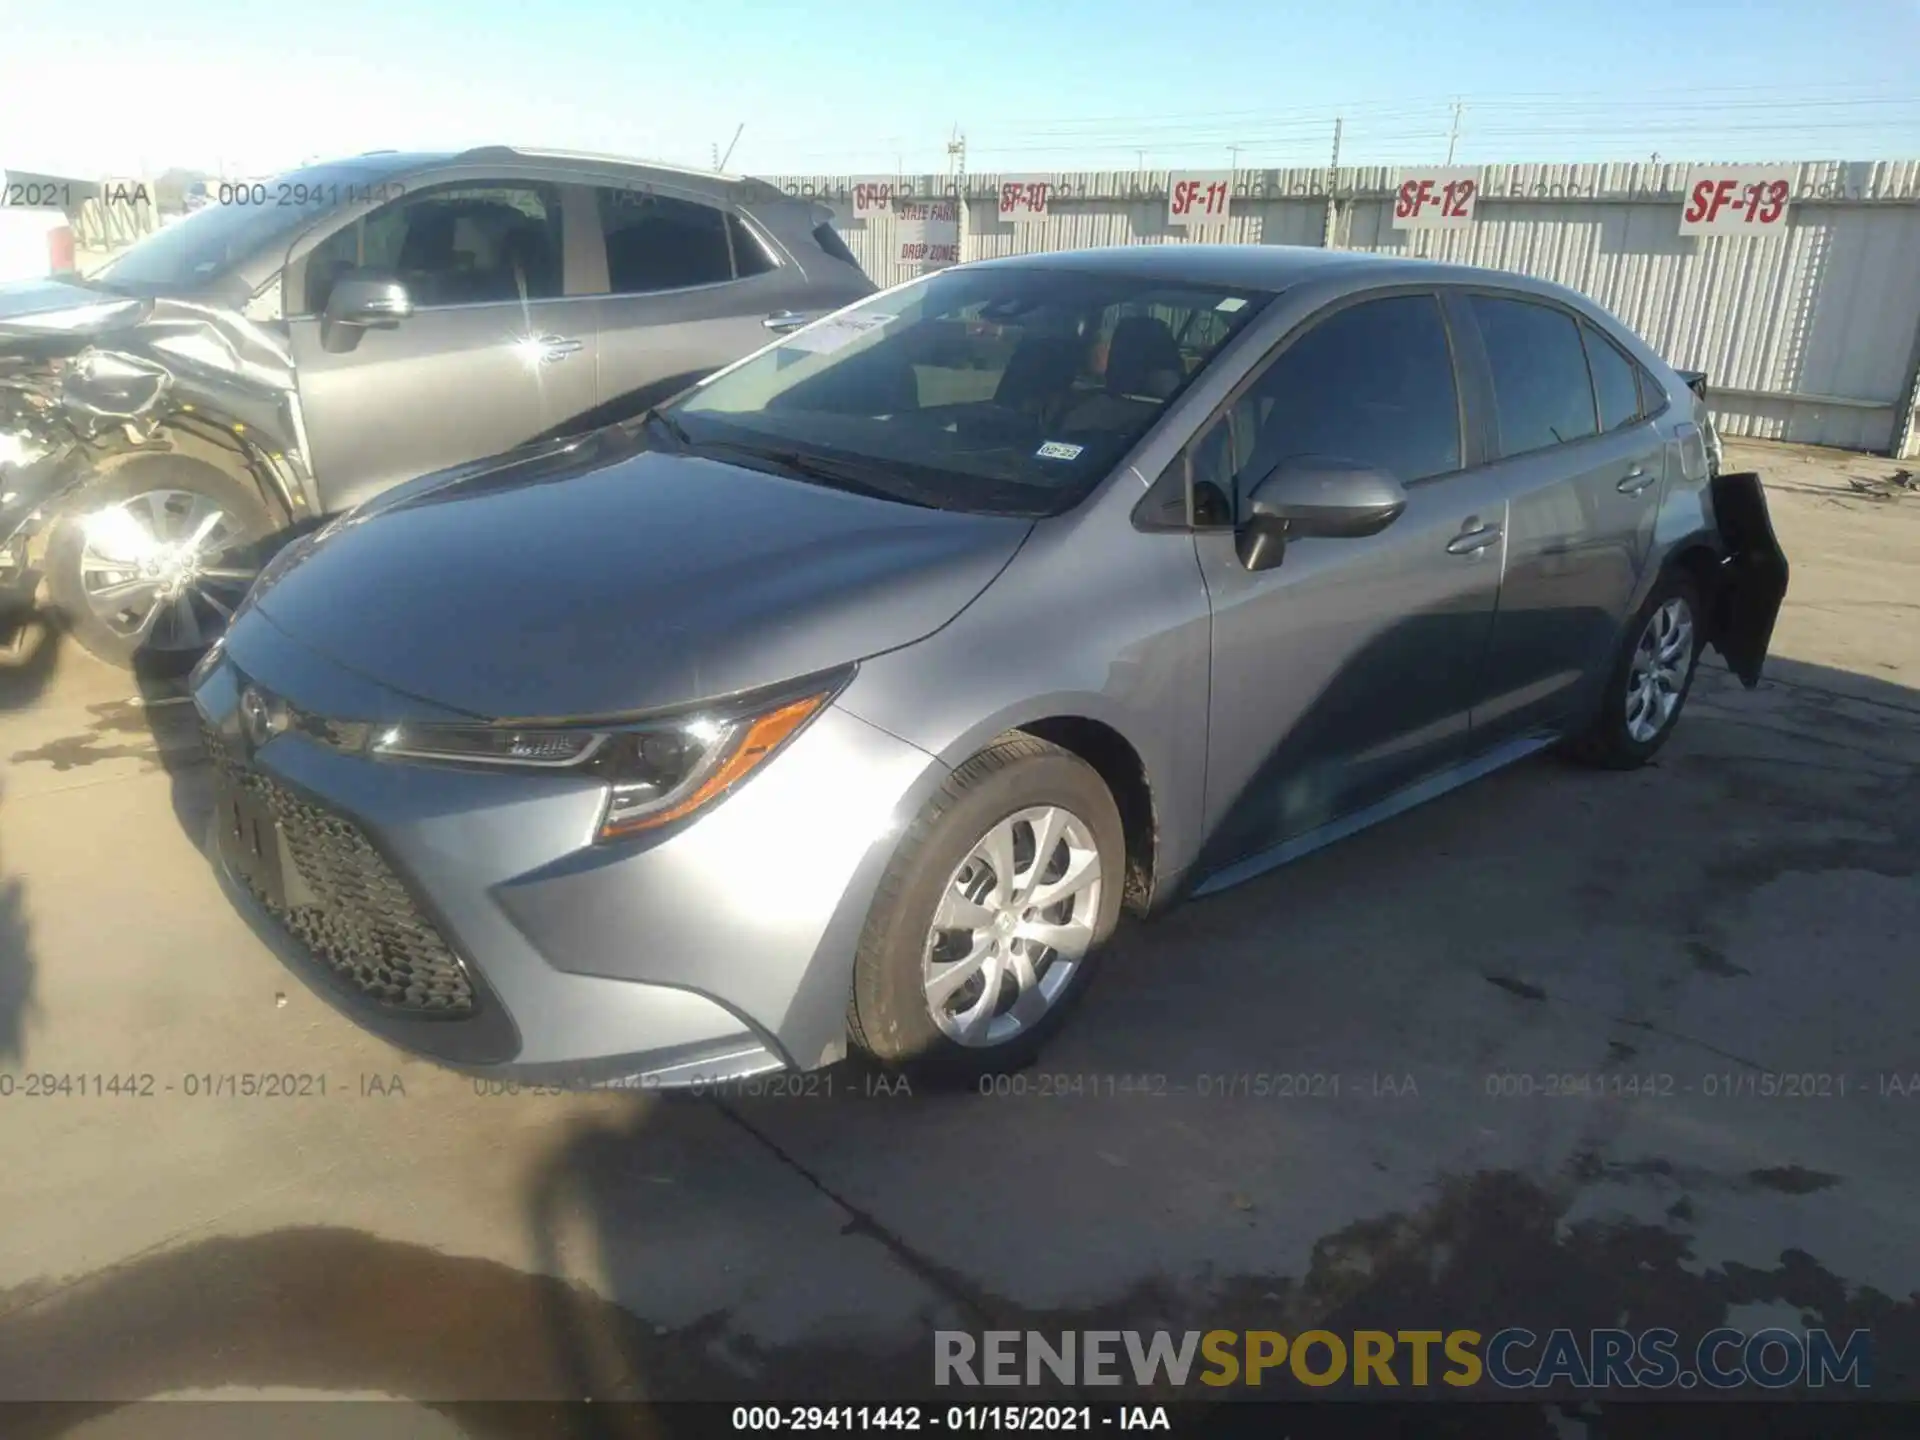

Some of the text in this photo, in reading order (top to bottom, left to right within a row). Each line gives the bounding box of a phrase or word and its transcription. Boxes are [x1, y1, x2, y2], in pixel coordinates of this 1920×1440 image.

[900, 204, 929, 221] STATE
[1001, 182, 1047, 213] SF-10
[1171, 181, 1228, 215] SF-11
[1396, 179, 1475, 218] SF-12
[1685, 179, 1790, 224] SF-13
[901, 243, 928, 260] DROP
